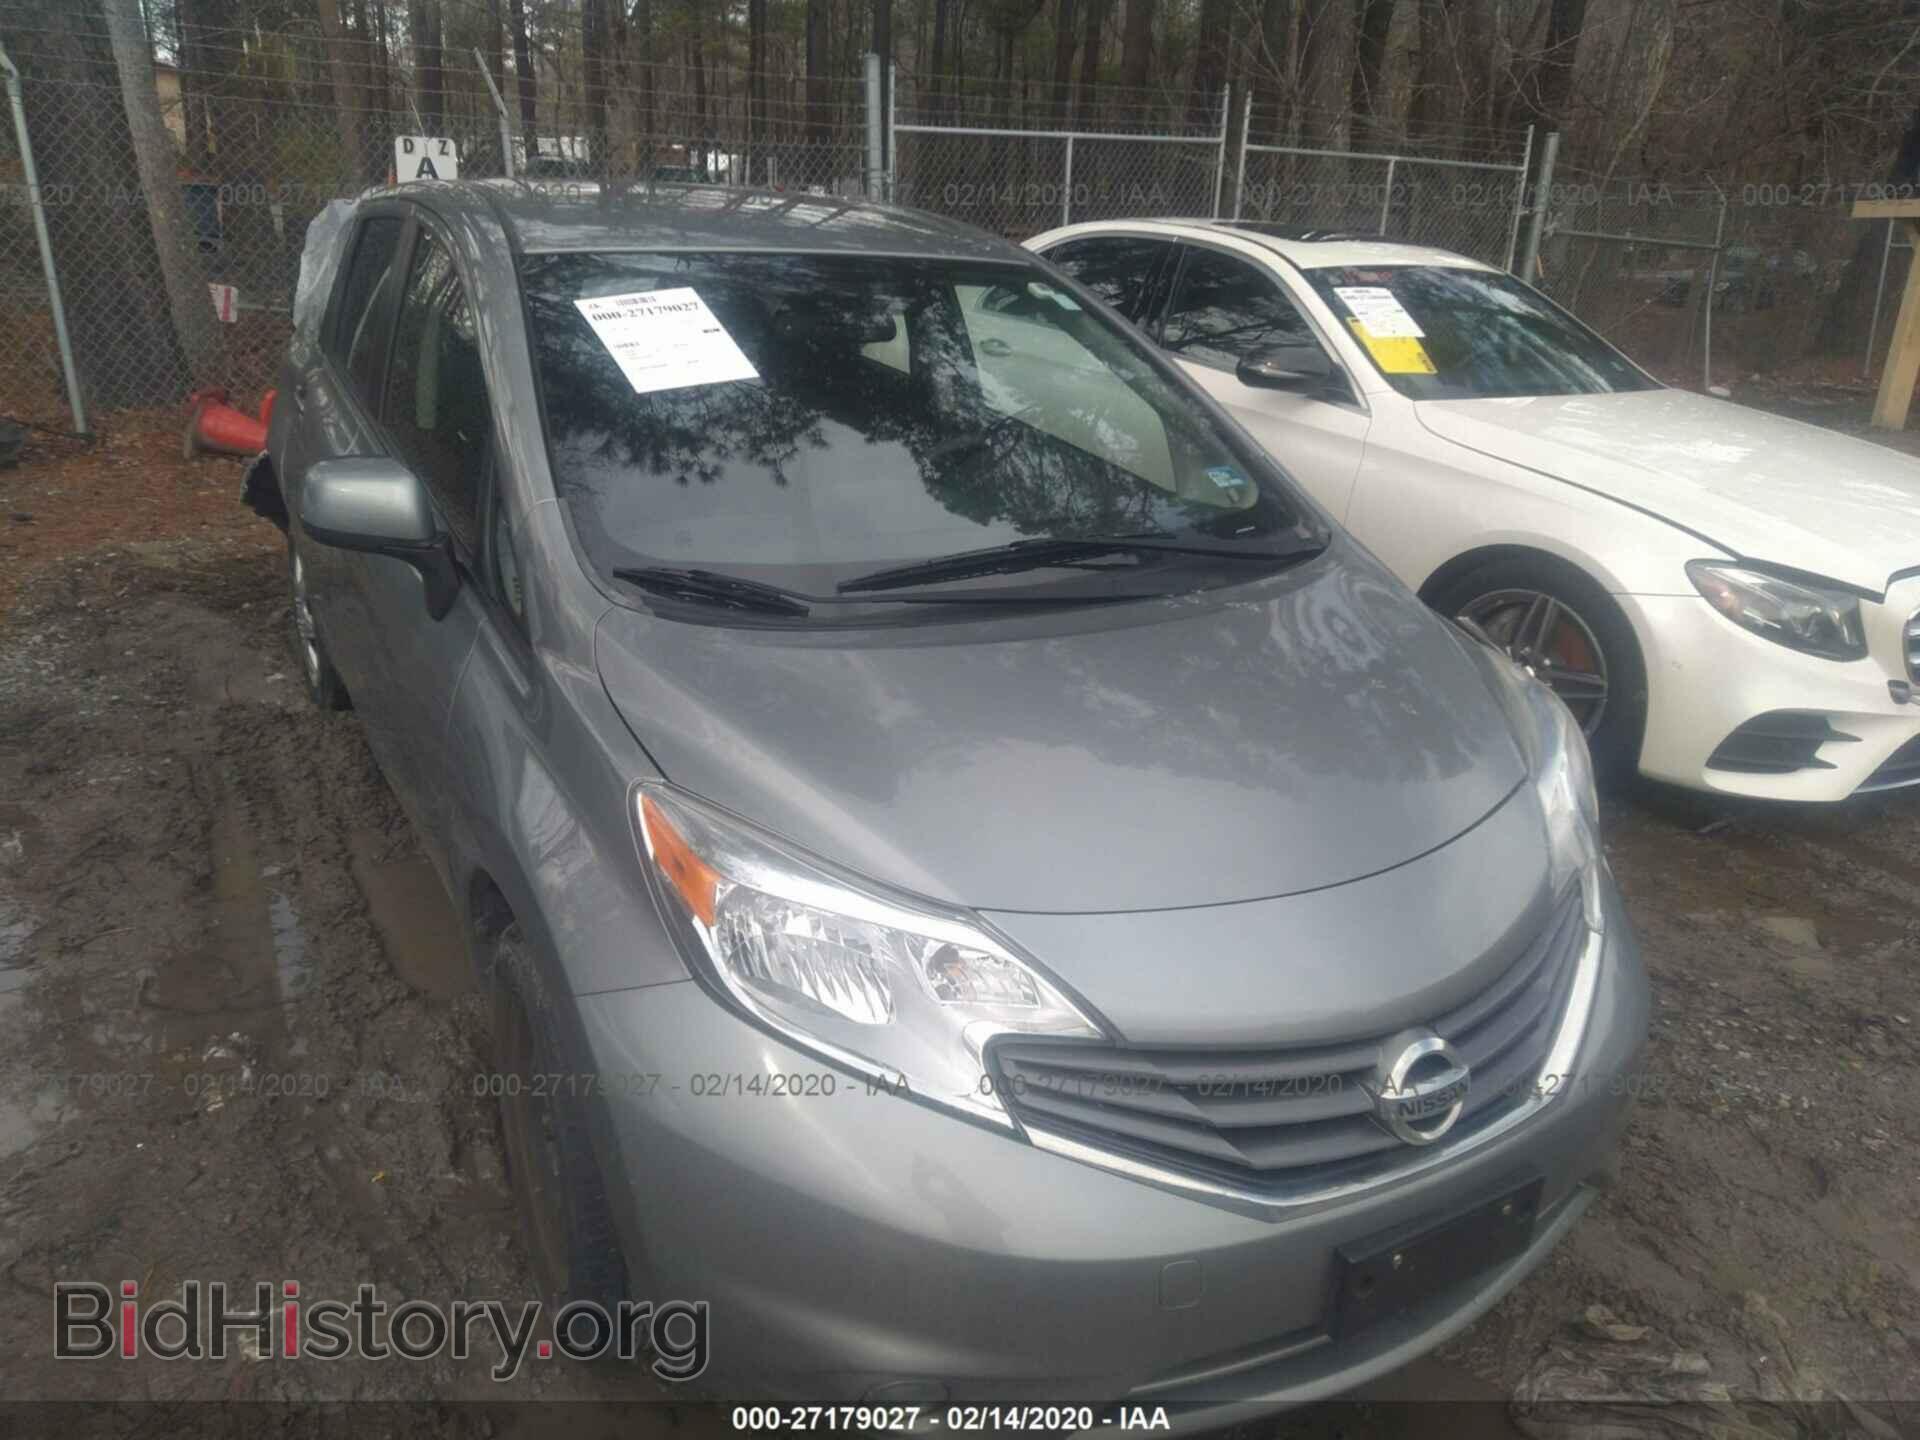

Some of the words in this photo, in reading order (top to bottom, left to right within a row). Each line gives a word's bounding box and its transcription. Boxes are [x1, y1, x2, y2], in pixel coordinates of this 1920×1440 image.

[402, 138, 414, 153] D
[439, 140, 449, 155] Z
[416, 156, 439, 179] A
[592, 302, 699, 321] 000-27179027
